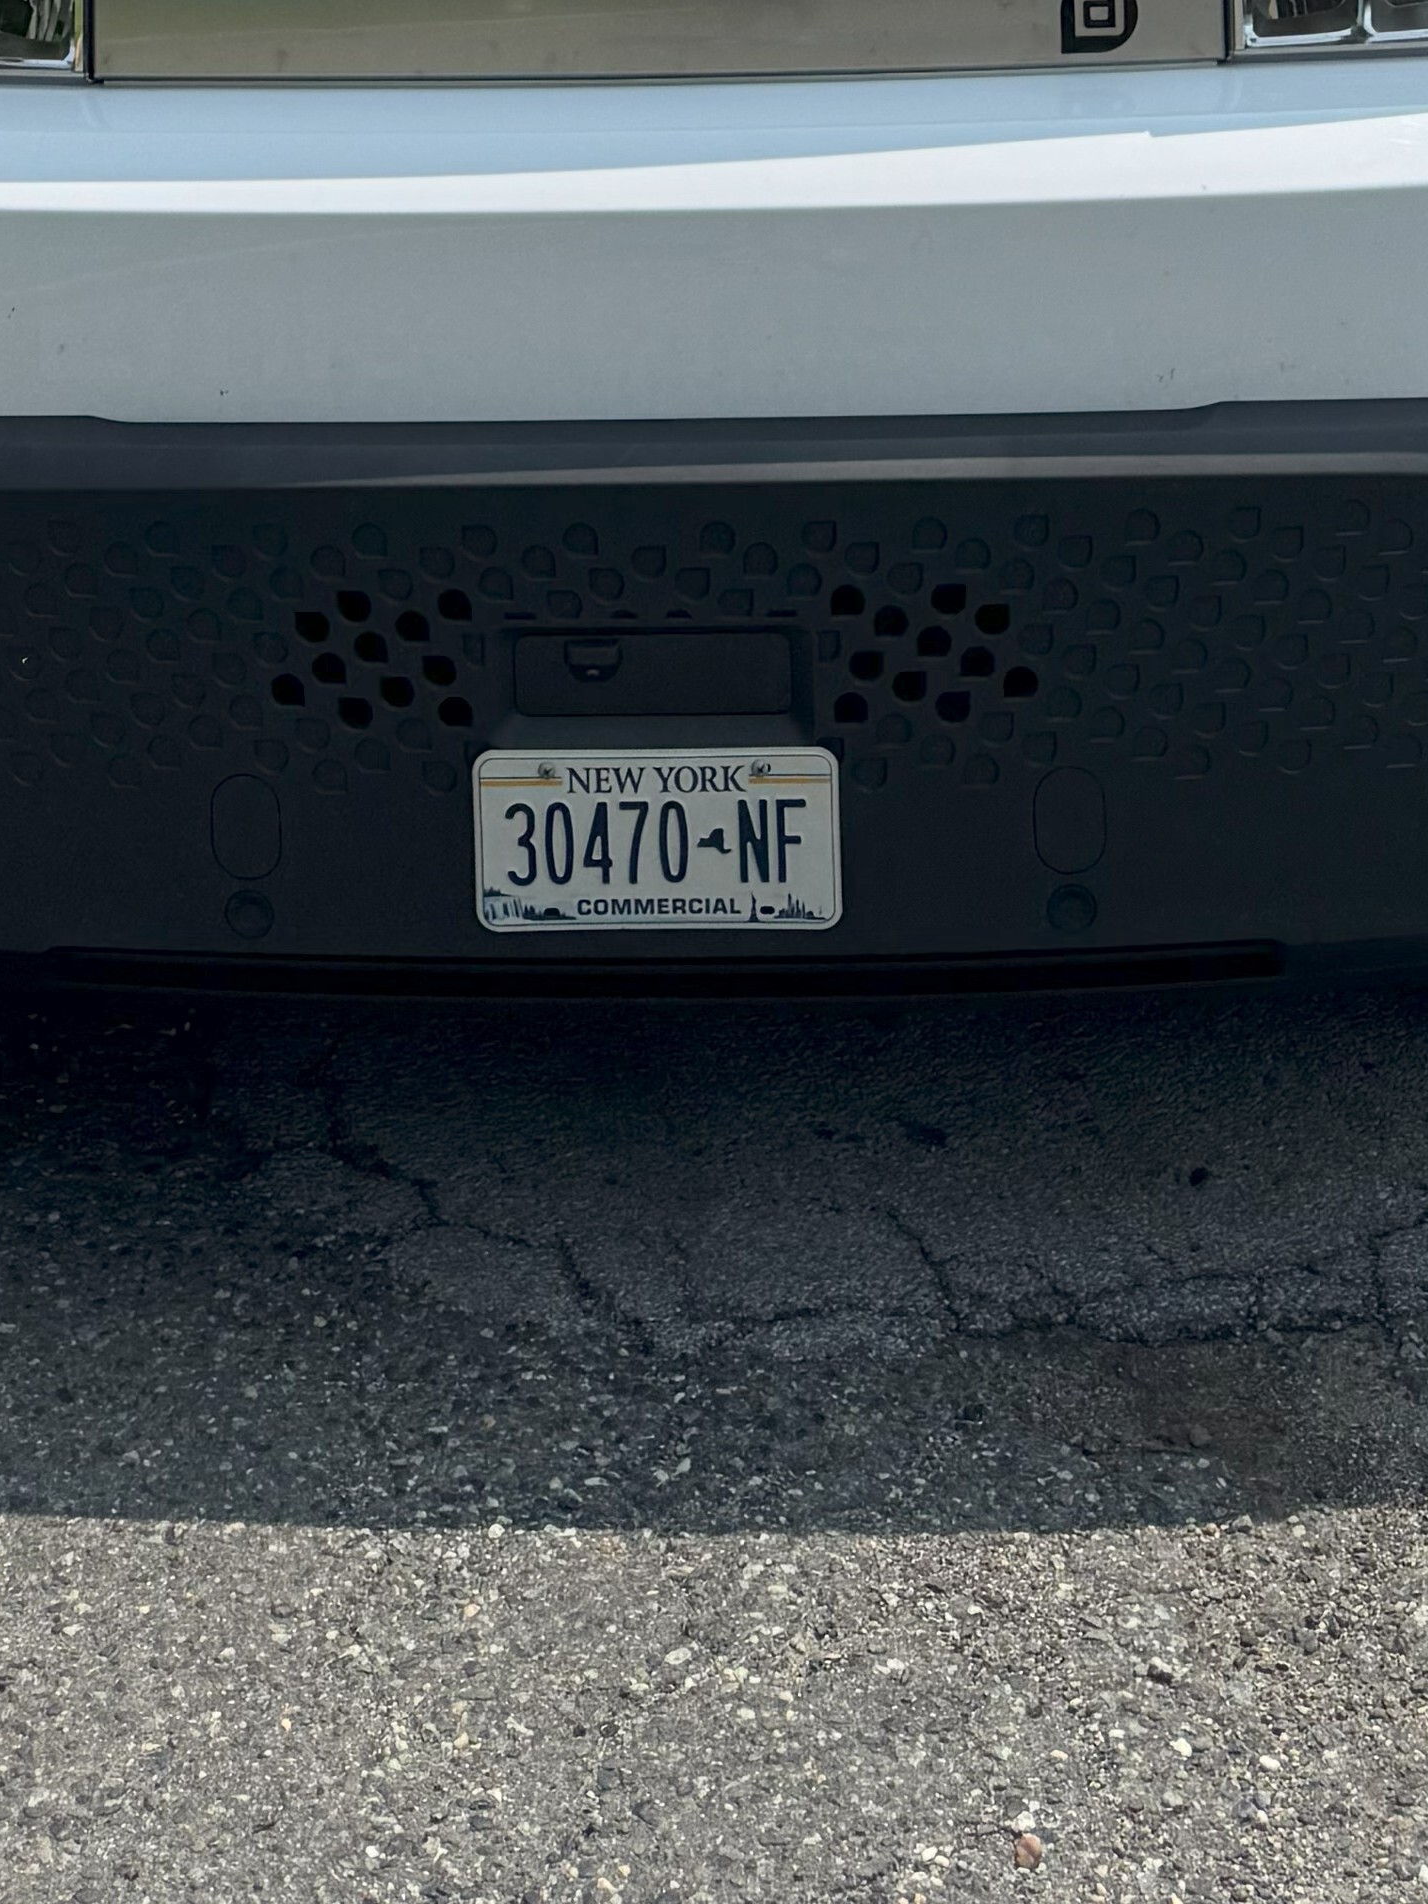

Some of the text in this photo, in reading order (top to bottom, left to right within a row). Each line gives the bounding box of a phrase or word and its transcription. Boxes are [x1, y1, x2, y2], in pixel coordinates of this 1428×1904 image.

[566, 765, 747, 794] NEW YORK
[504, 798, 807, 886] 30470 NF
[576, 897, 742, 917] COMMERCIAL
